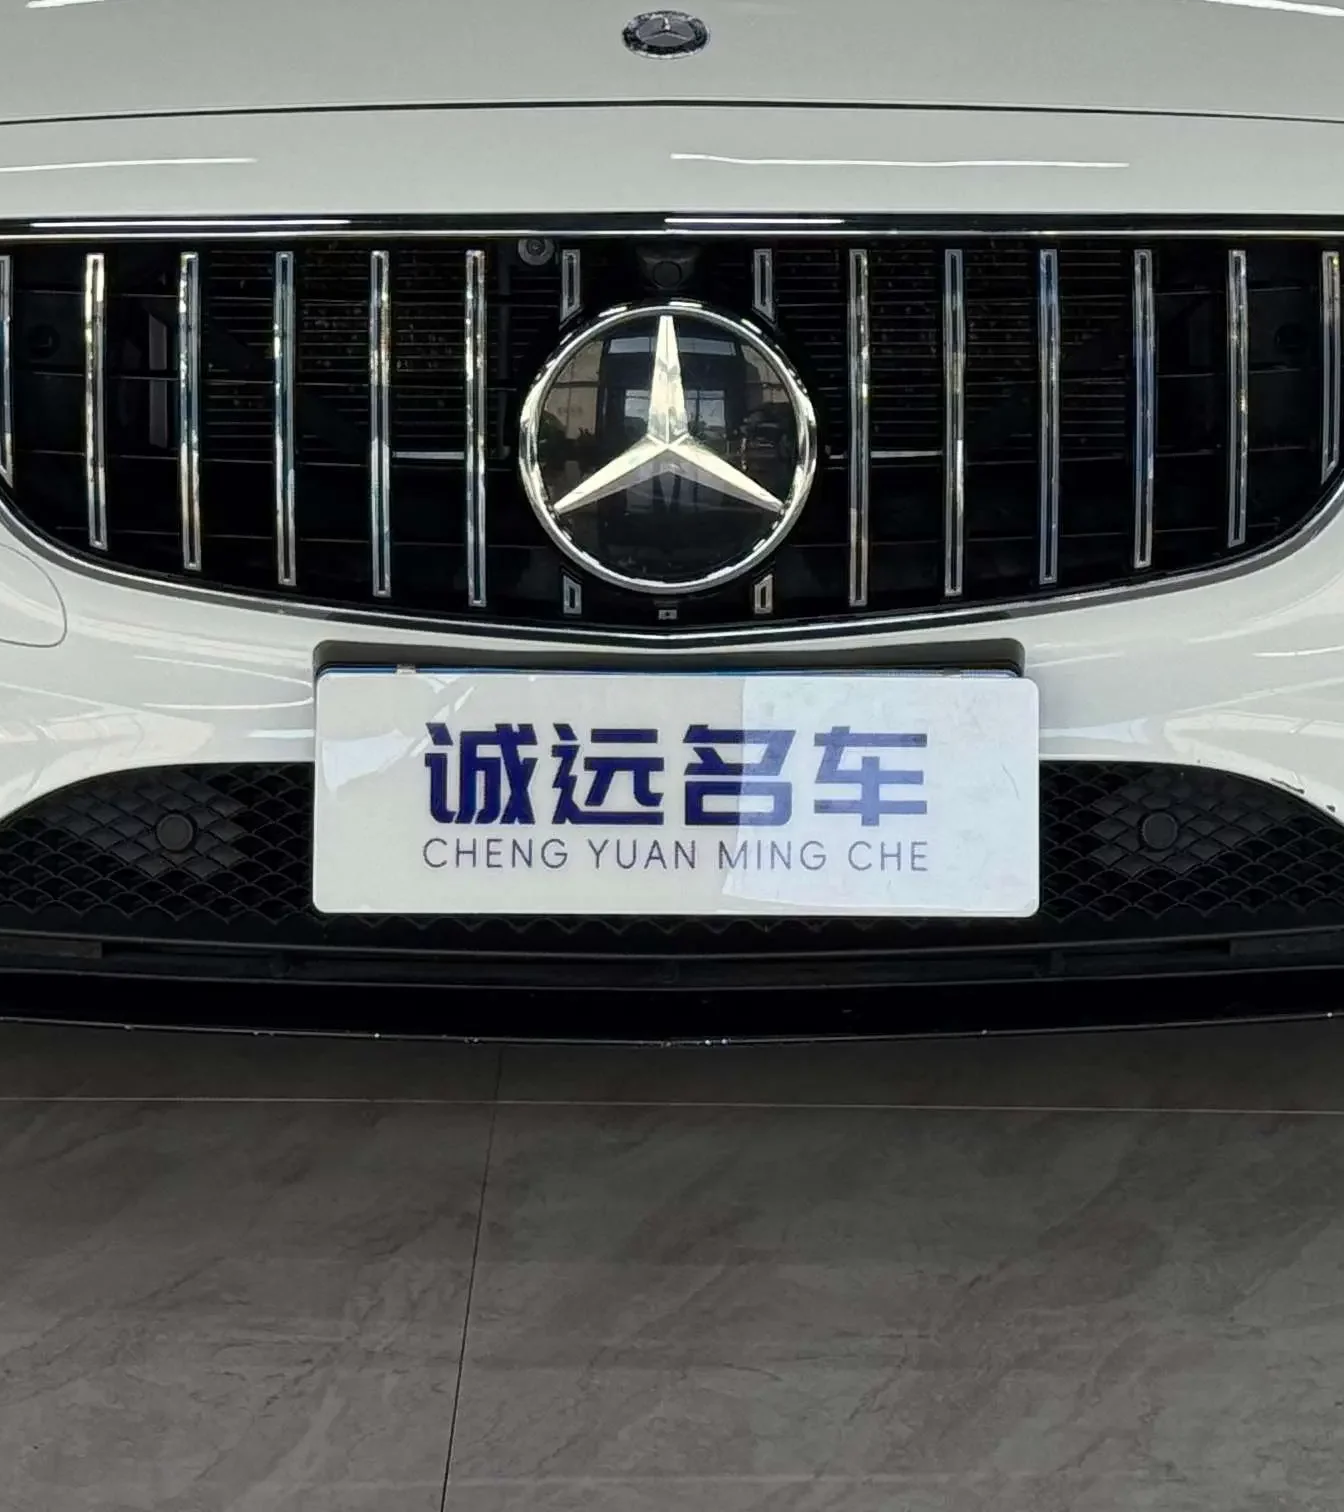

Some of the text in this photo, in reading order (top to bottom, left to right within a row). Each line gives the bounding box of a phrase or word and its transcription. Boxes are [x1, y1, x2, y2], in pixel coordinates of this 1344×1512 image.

[424, 722, 929, 827] 诚远名车
[421, 836, 929, 872] CHENG YUAN MING CHE
